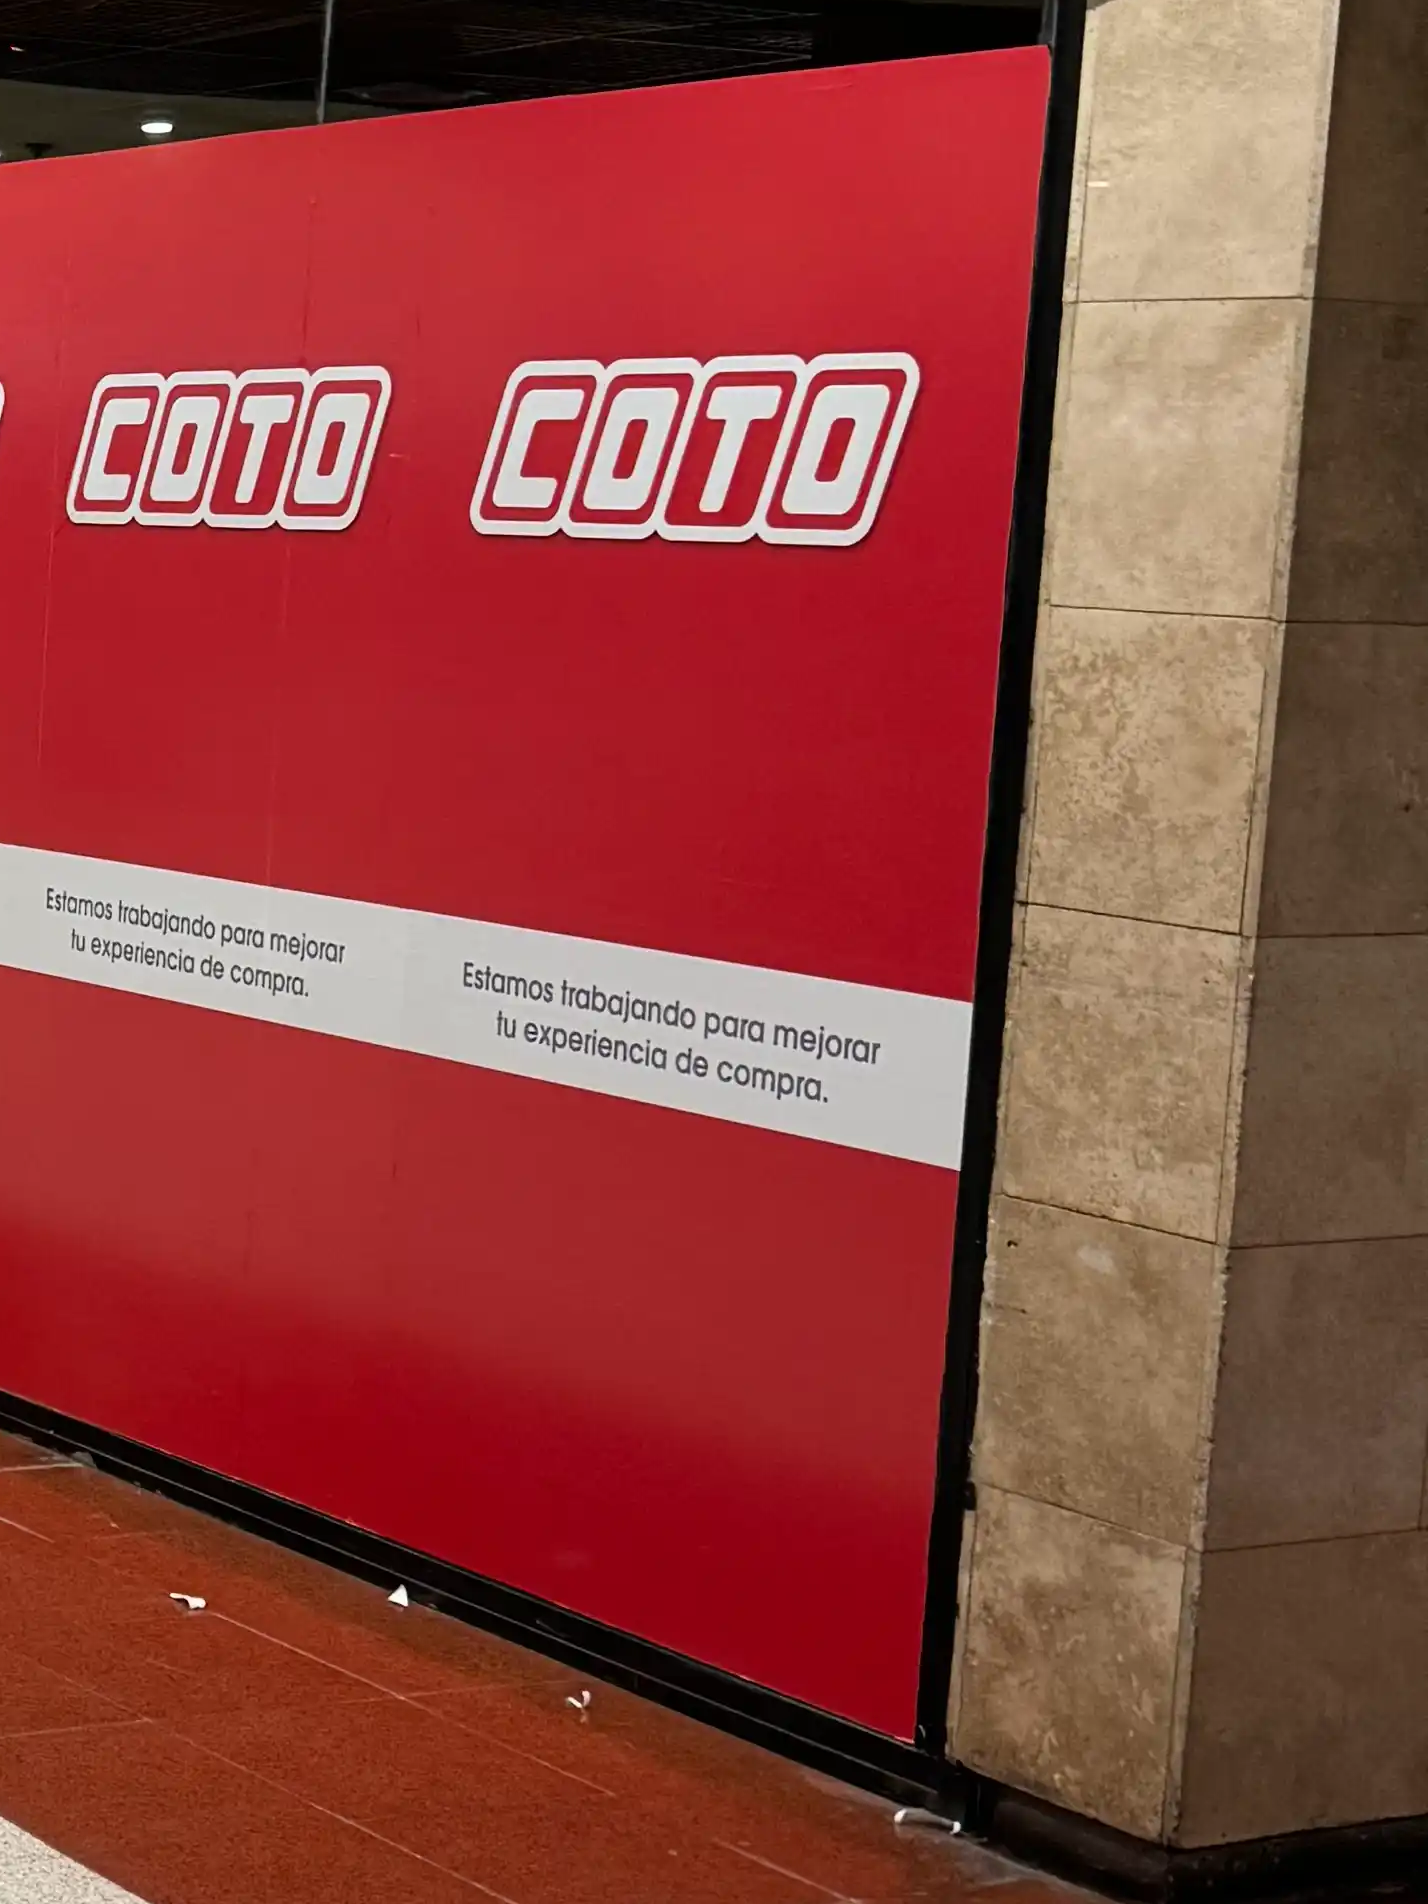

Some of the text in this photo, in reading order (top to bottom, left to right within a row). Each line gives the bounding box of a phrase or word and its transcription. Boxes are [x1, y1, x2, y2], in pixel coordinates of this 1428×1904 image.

[67, 365, 392, 530] COTO
[470, 351, 921, 548] COTO
[46, 888, 345, 964] Estamos trabajando para mejorar
[71, 928, 309, 997] tu experiencia de compra.
[463, 962, 881, 1065] Estamos trabajando para mejorar
[497, 1011, 828, 1103] tu experiencia de compra.
